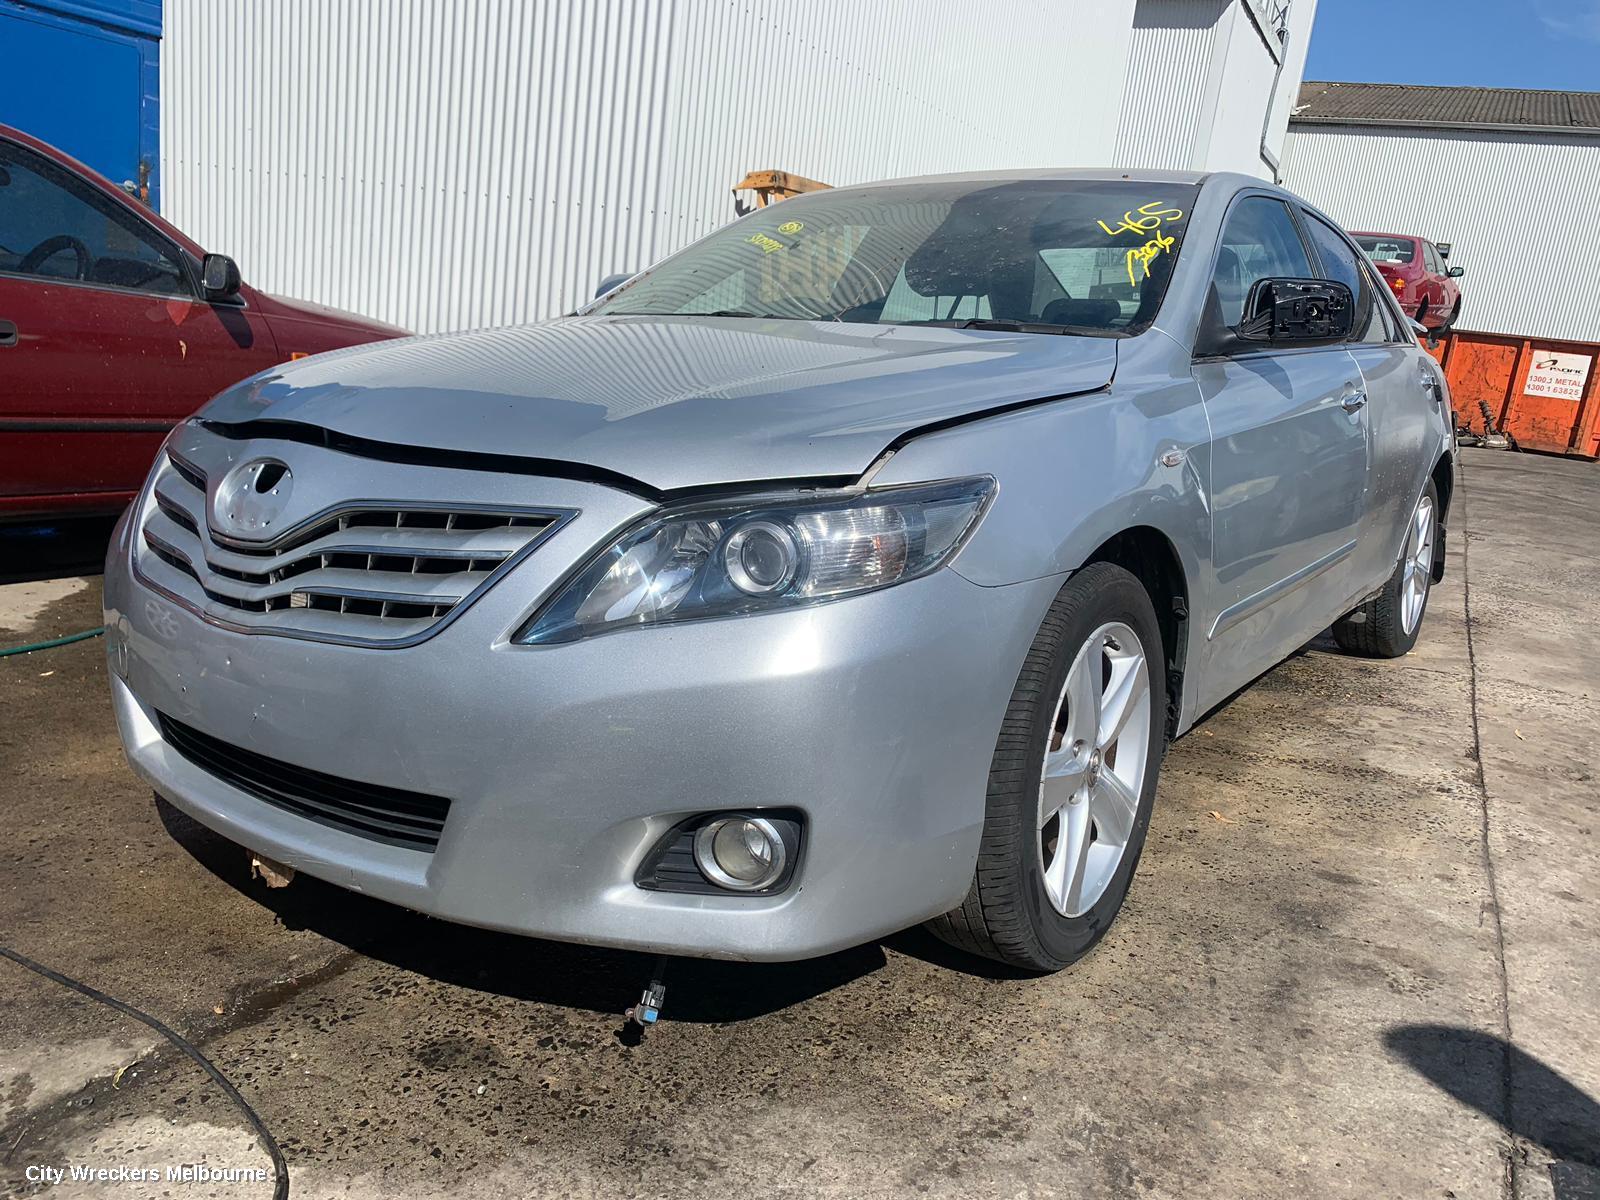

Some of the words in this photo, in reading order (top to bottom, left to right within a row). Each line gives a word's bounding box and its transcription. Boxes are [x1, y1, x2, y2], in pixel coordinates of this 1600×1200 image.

[1097, 201, 1183, 235] 465
[1529, 375, 1547, 383] 1300
[1555, 378, 1583, 388] METAL
[1553, 386, 1579, 396] 63825
